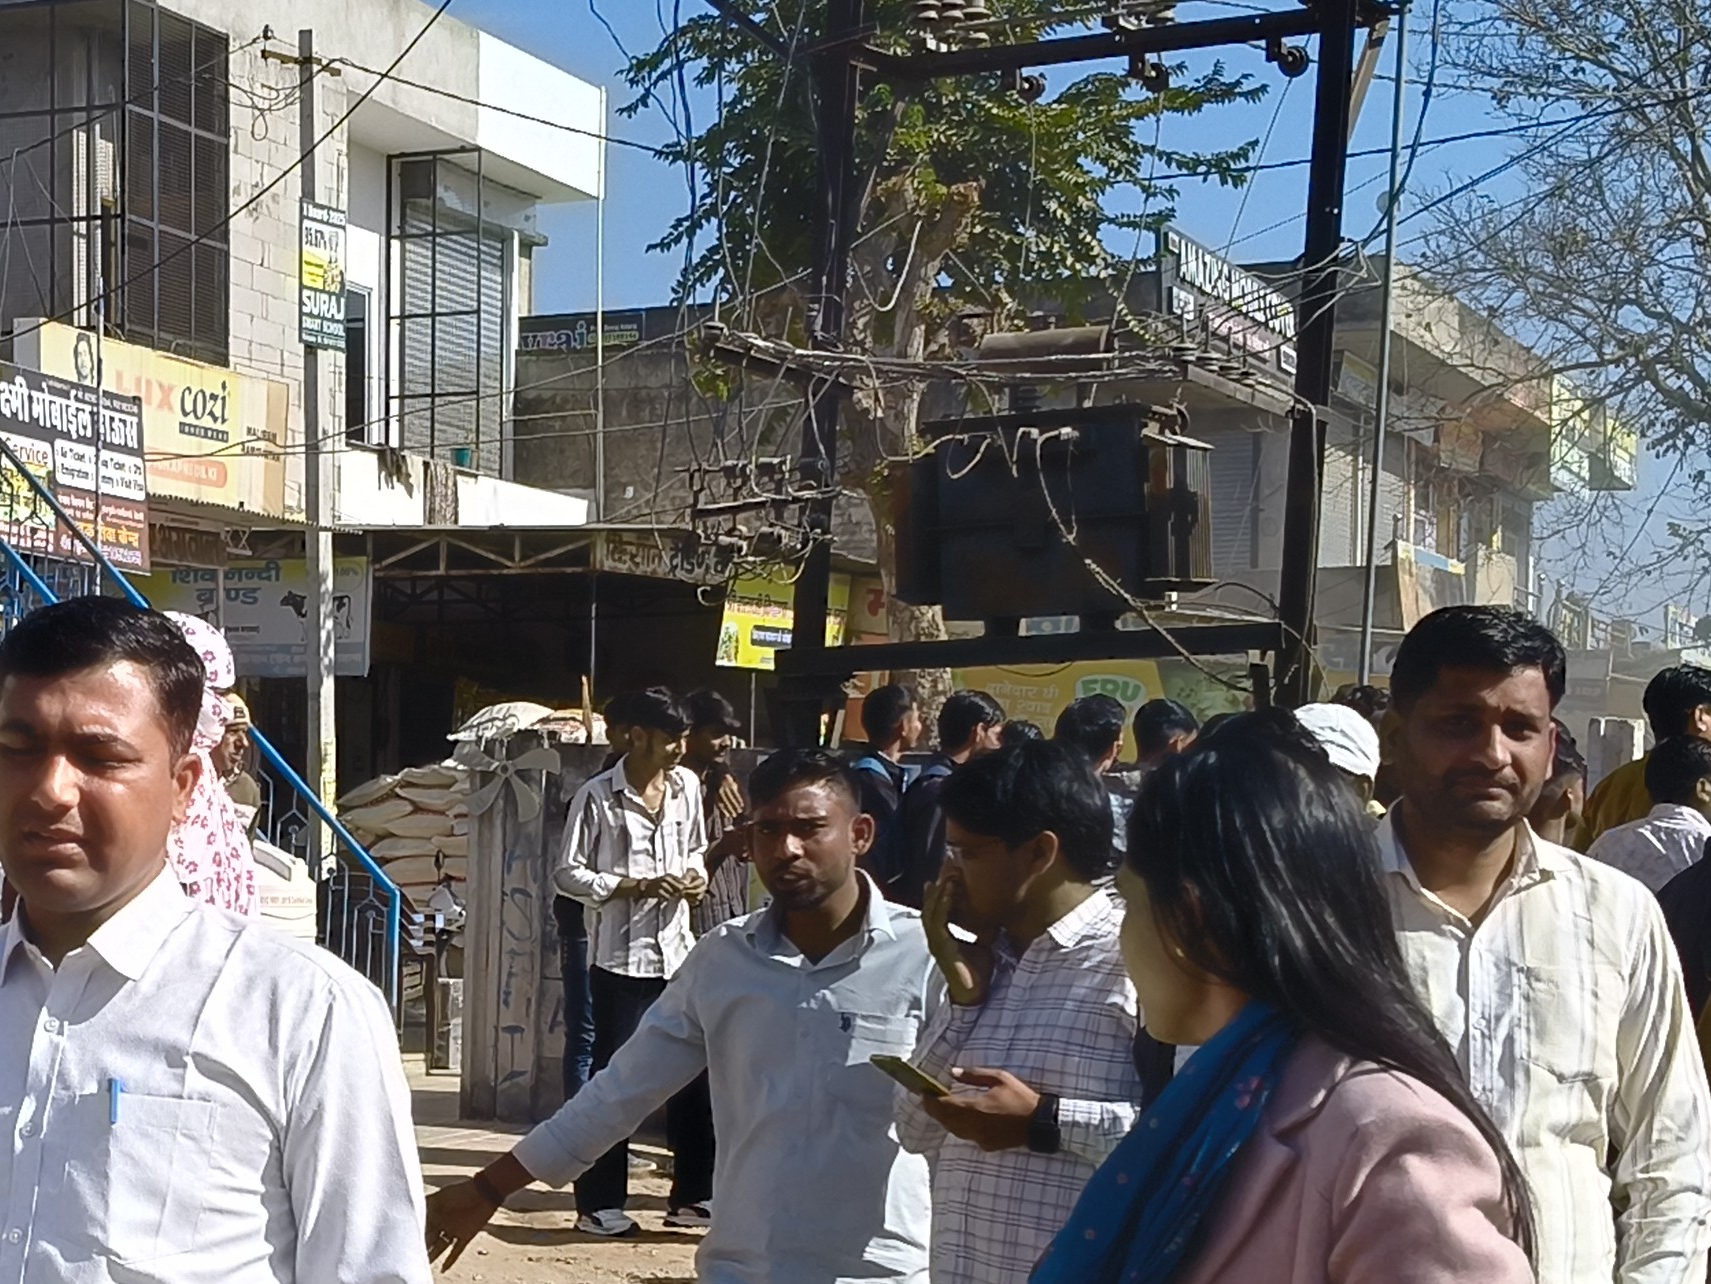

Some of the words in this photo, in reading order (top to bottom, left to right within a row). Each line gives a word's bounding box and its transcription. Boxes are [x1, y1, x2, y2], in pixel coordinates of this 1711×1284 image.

[301, 289, 346, 322] SURAJ
[30, 379, 93, 440] मोबाईल
[115, 368, 177, 415] LUX
[179, 380, 231, 426] cozi
